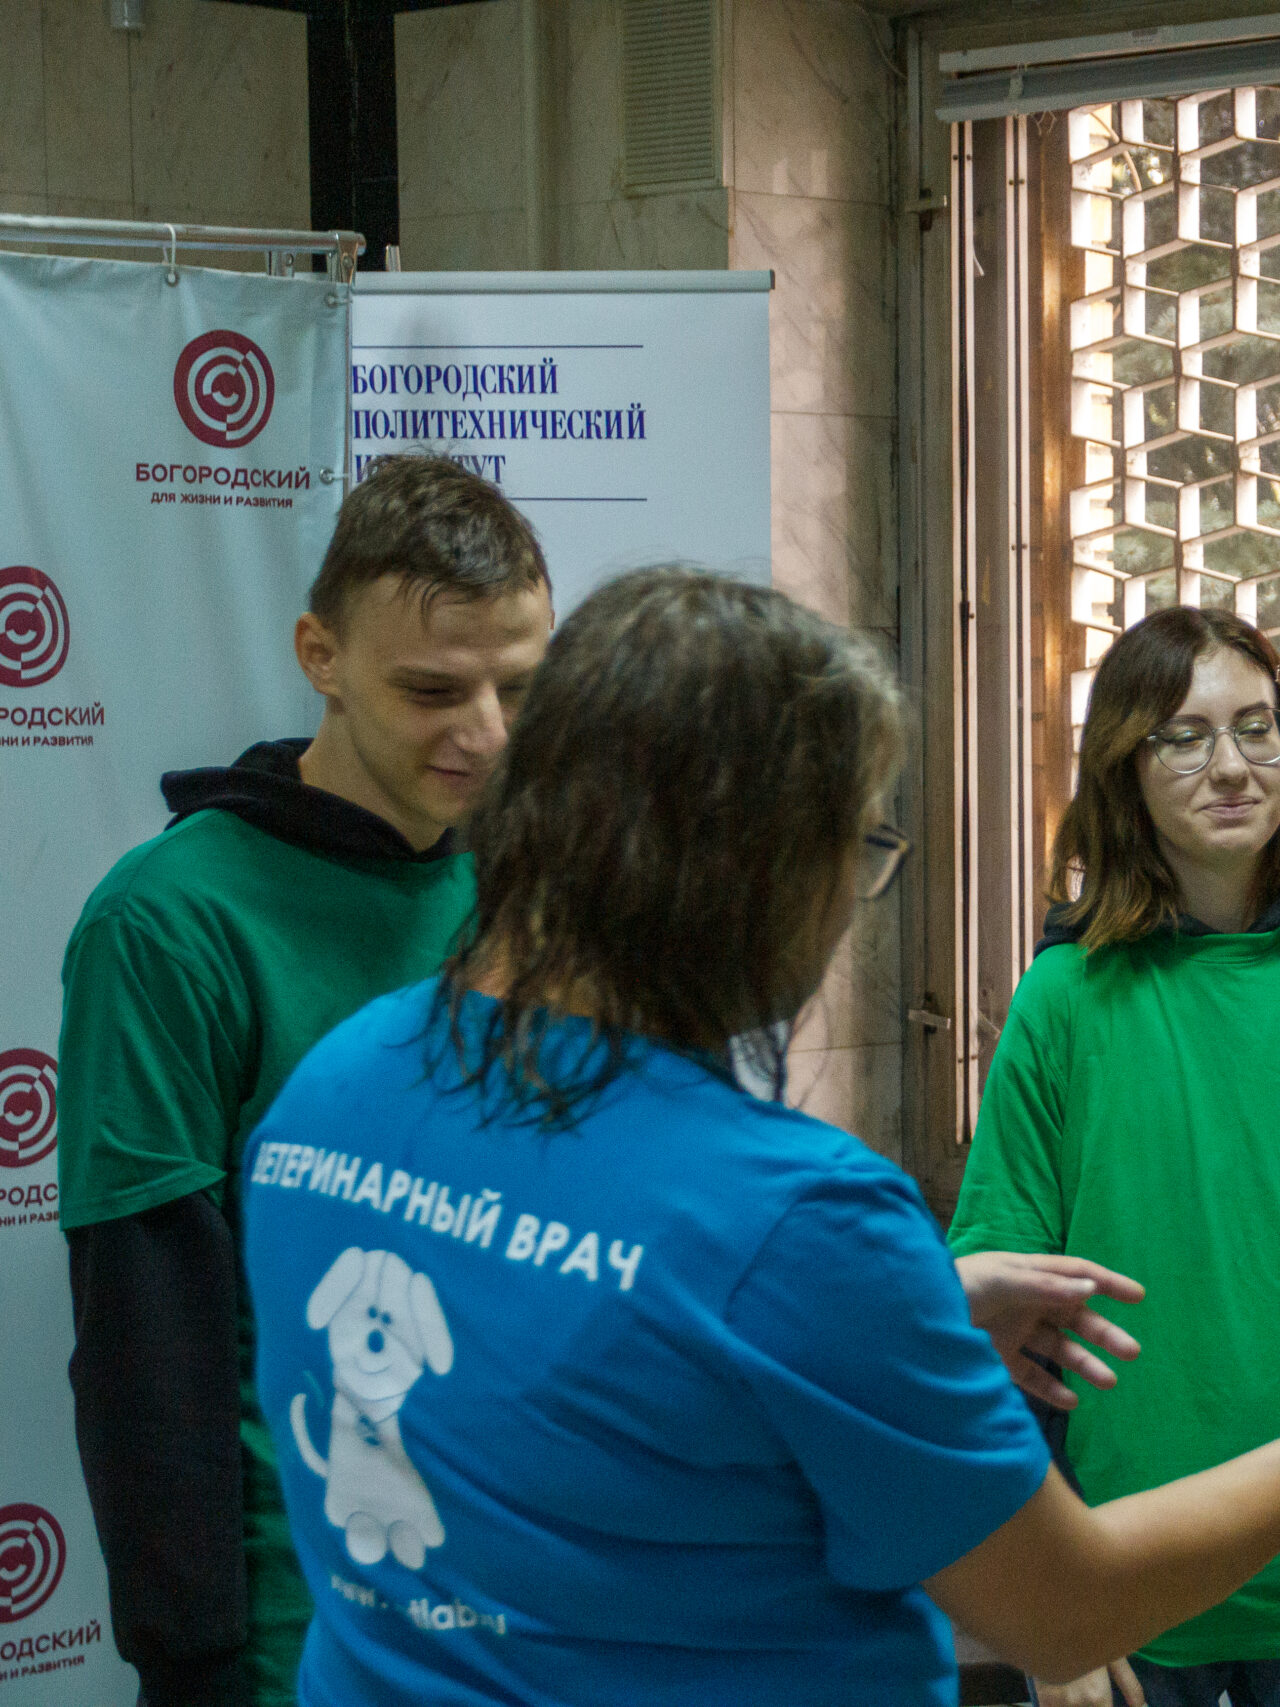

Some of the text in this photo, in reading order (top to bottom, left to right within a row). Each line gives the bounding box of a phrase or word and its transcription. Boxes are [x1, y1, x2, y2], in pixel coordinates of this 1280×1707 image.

[351, 357, 559, 401] БОГОРОДСКИЙ
[353, 402, 647, 440] ПОЛИТЕХНИЧЕСКИЙ
[136, 463, 310, 491] БОГОРОДСКИЙ
[151, 492, 293, 508] ДЛЯ ЖИЗНИ И РАЗВИТИЯ
[0, 701, 105, 730] РОДСКИЙ
[21, 736, 30, 746] И
[33, 736, 93, 746] РАЗВИТИЯ
[505, 1213, 644, 1292] ВРАЧ
[0, 1619, 101, 1662] ОДСКИЙ
[21, 1655, 84, 1676] РАЗВИТИЯ
